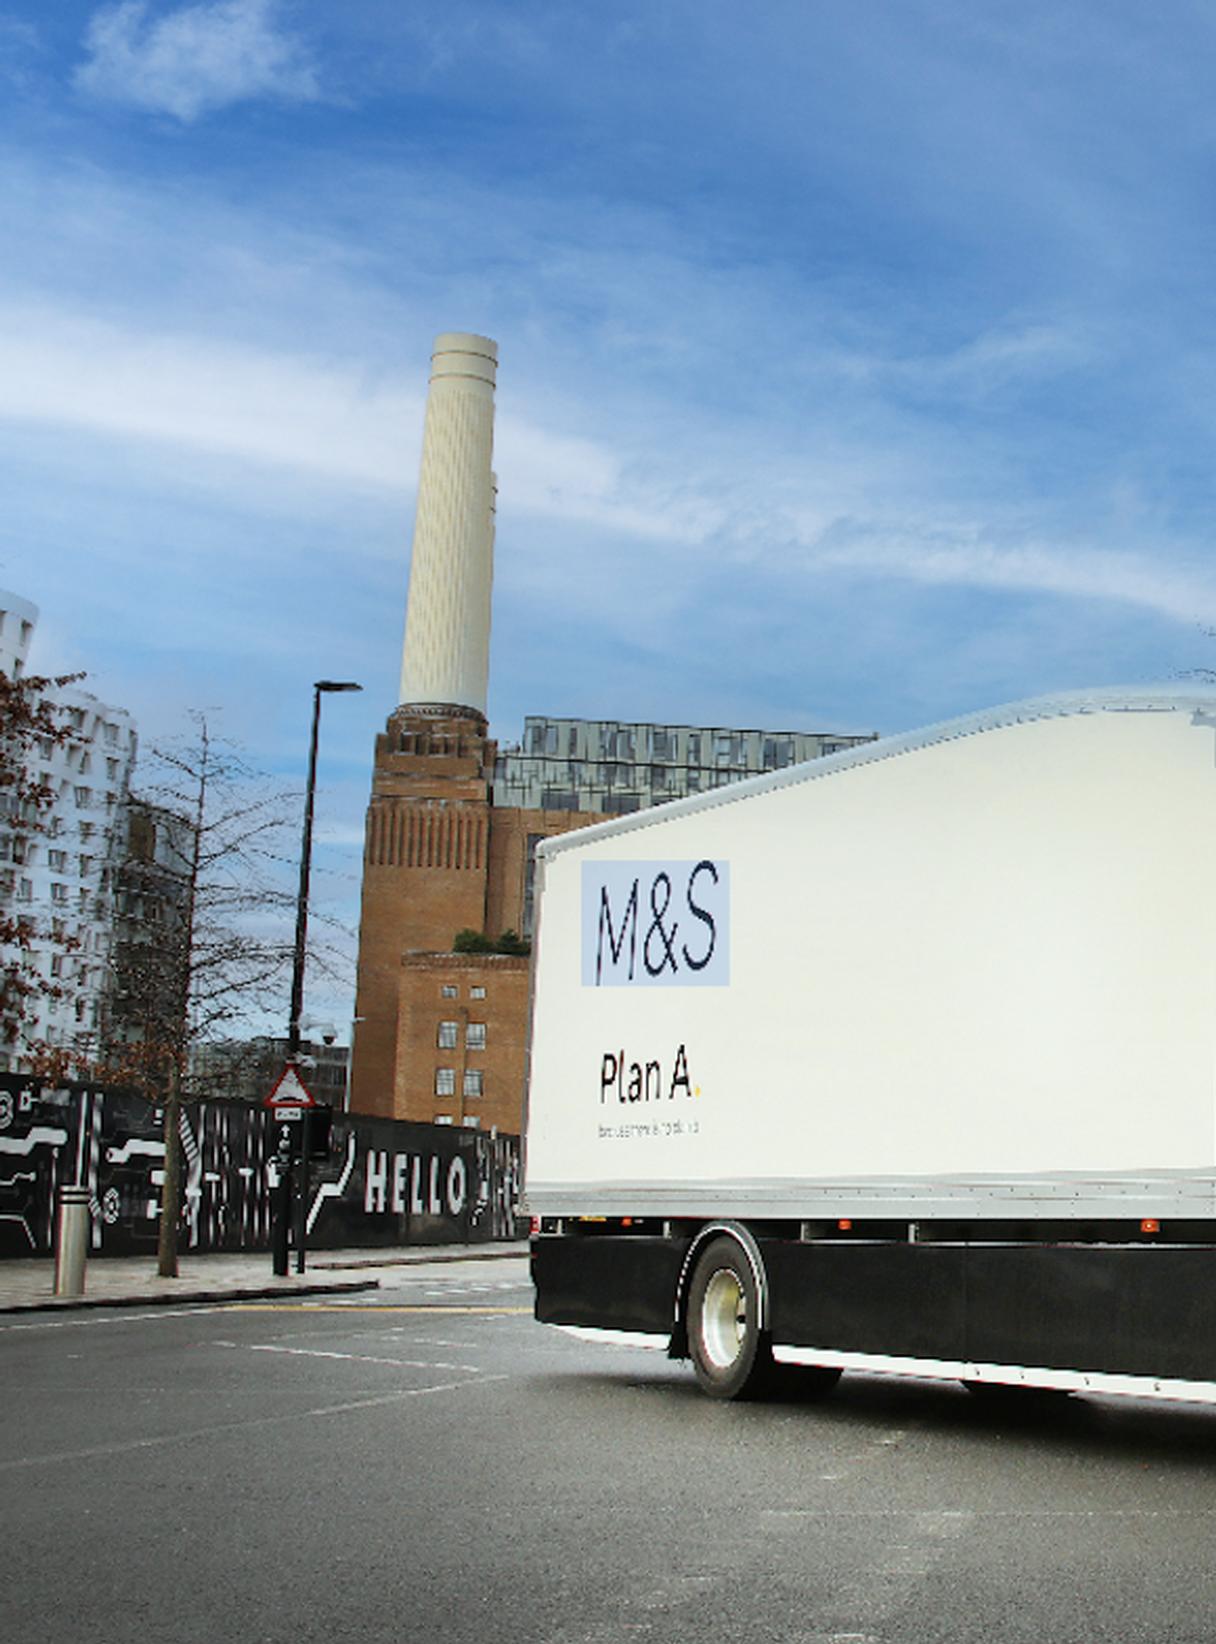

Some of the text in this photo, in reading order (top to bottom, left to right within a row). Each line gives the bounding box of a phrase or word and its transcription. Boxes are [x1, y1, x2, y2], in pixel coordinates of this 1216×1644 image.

[596, 859, 719, 986] M&S
[600, 1049, 661, 1103] Plan
[364, 1150, 466, 1215] HELLO
